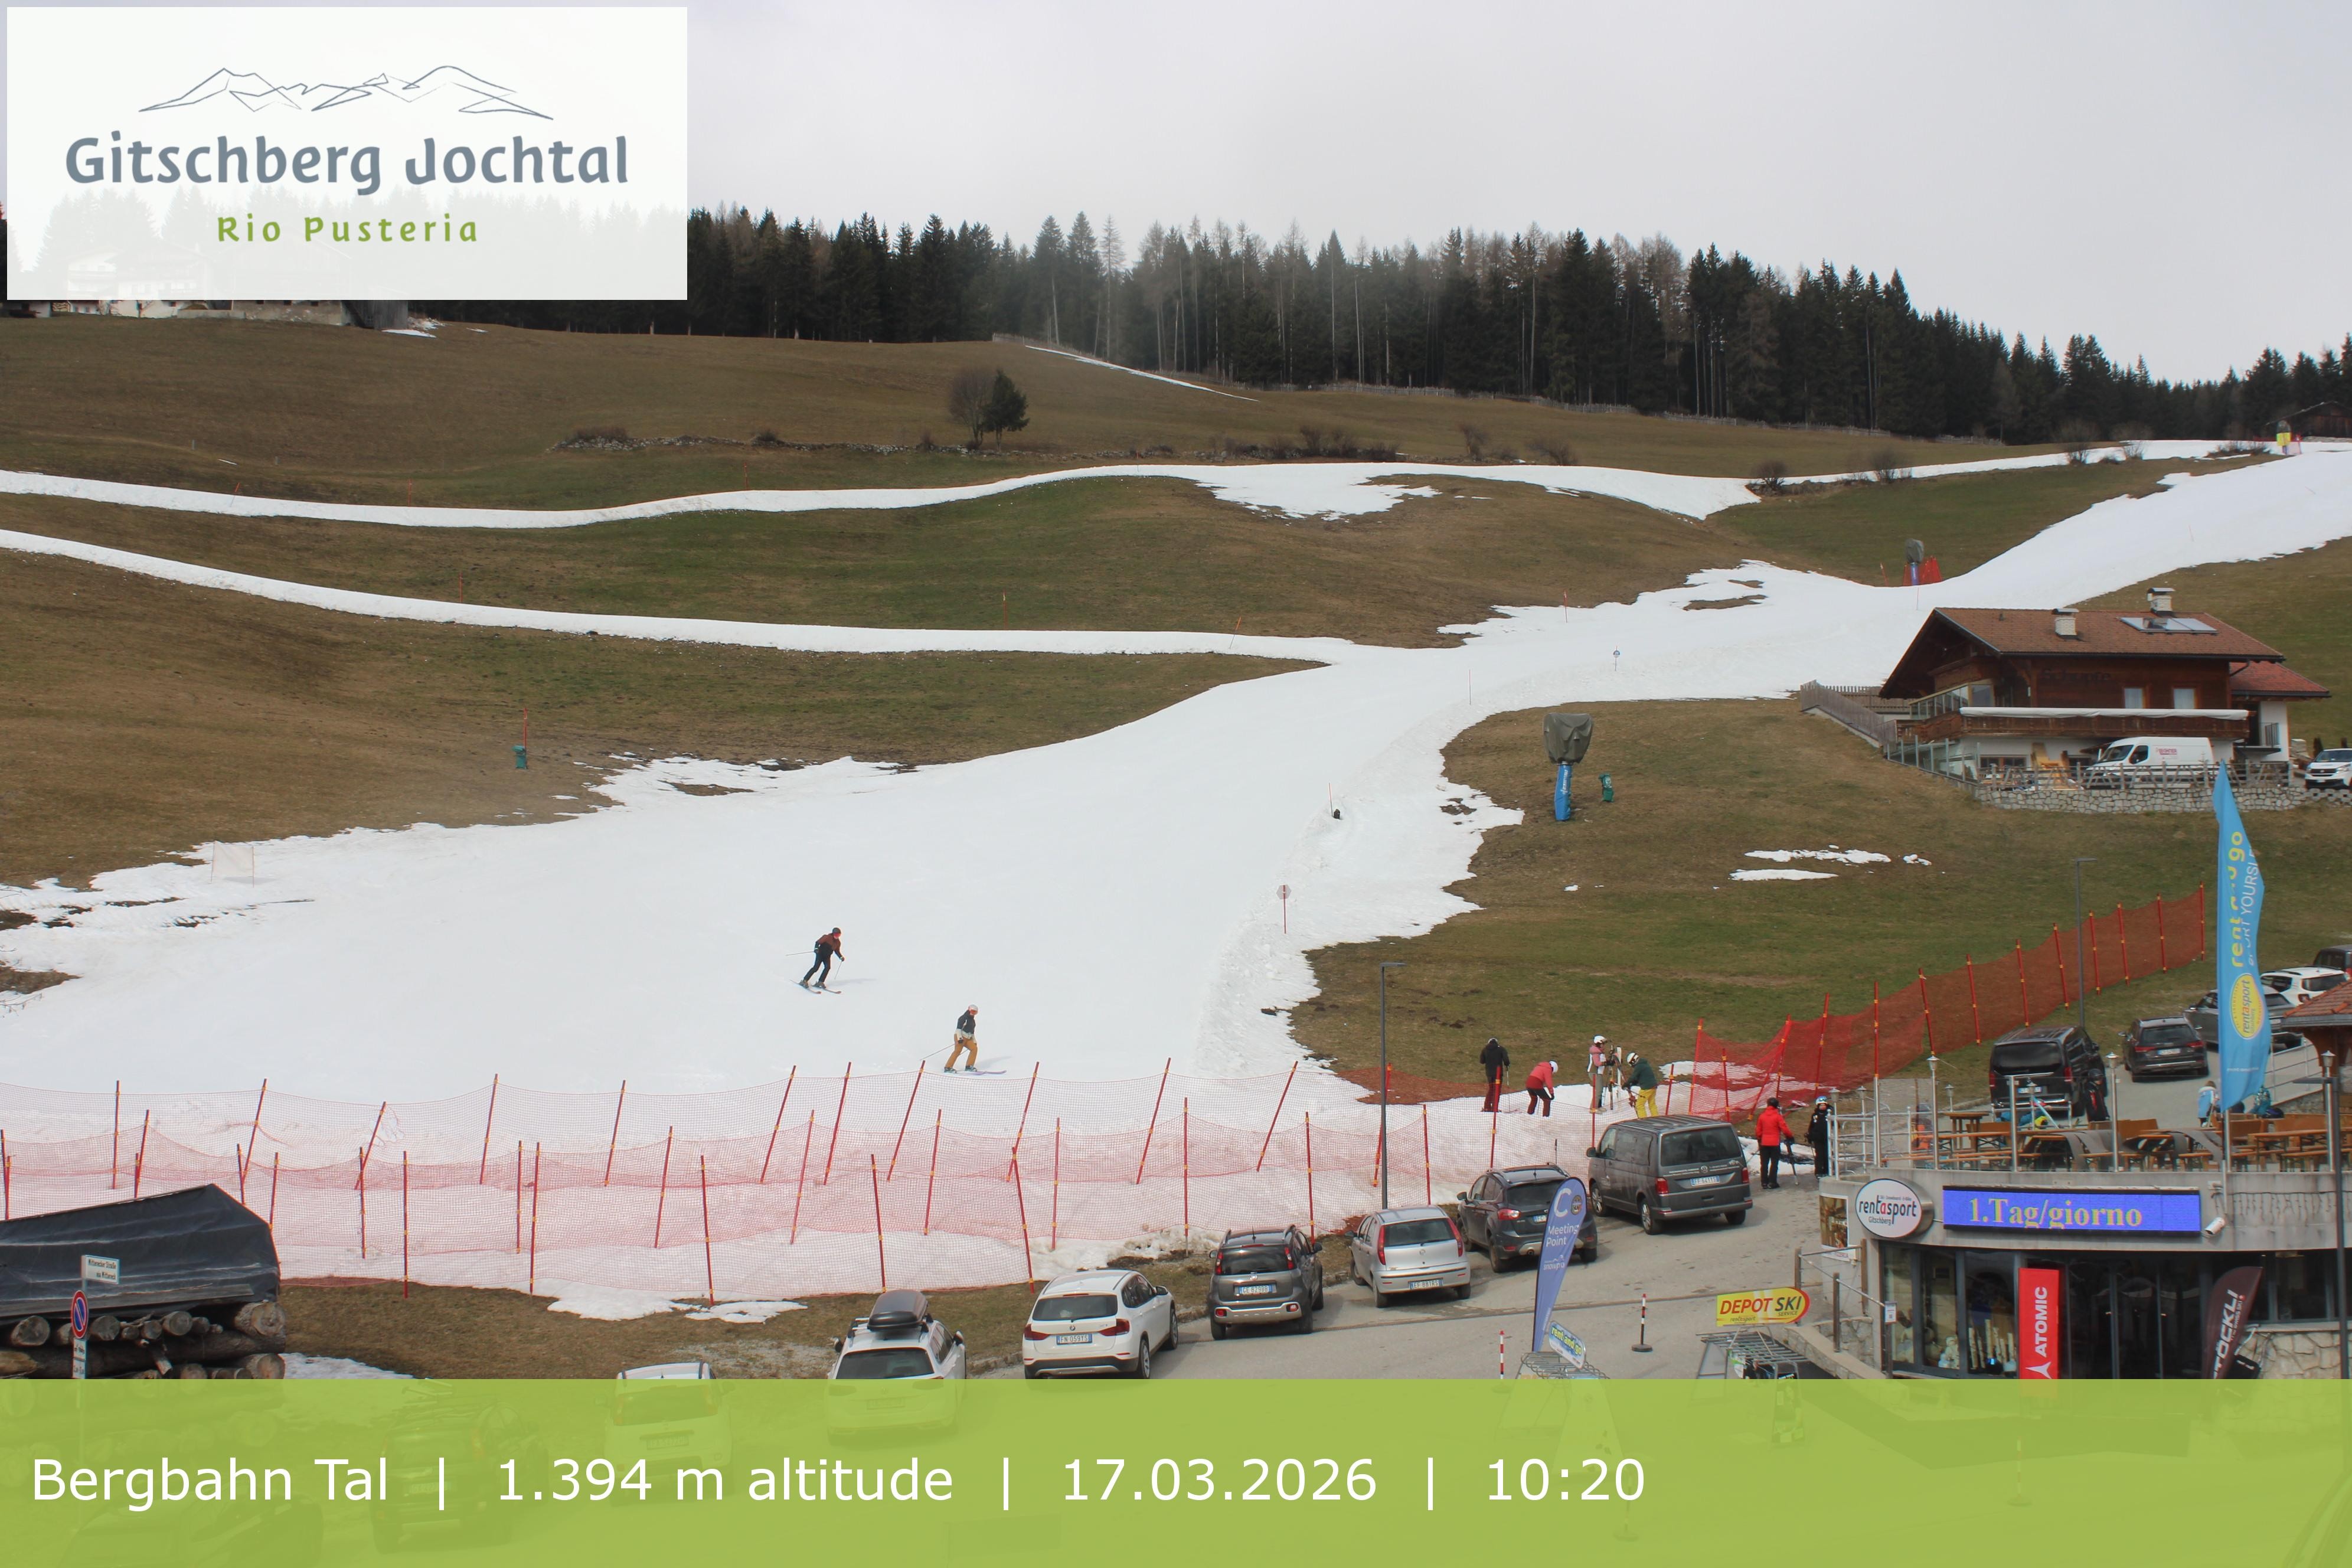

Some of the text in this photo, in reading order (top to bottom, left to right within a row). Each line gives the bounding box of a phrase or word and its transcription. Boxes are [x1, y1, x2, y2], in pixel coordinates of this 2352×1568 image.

[1858, 1194, 1917, 1224] rentasport
[1868, 1216, 1892, 1226] Gitschberg
[1969, 1197, 2143, 1230] 1.Tag/giorno
[1548, 1223, 1580, 1235] Meeting
[1546, 1236, 1567, 1247] Point
[1719, 1295, 1803, 1315] DEPOT SKI
[2034, 1286, 2047, 1358] ATOMIC
[1551, 1327, 1564, 1341] rent
[1564, 1336, 1574, 1349] and
[1575, 1344, 1582, 1355] go
